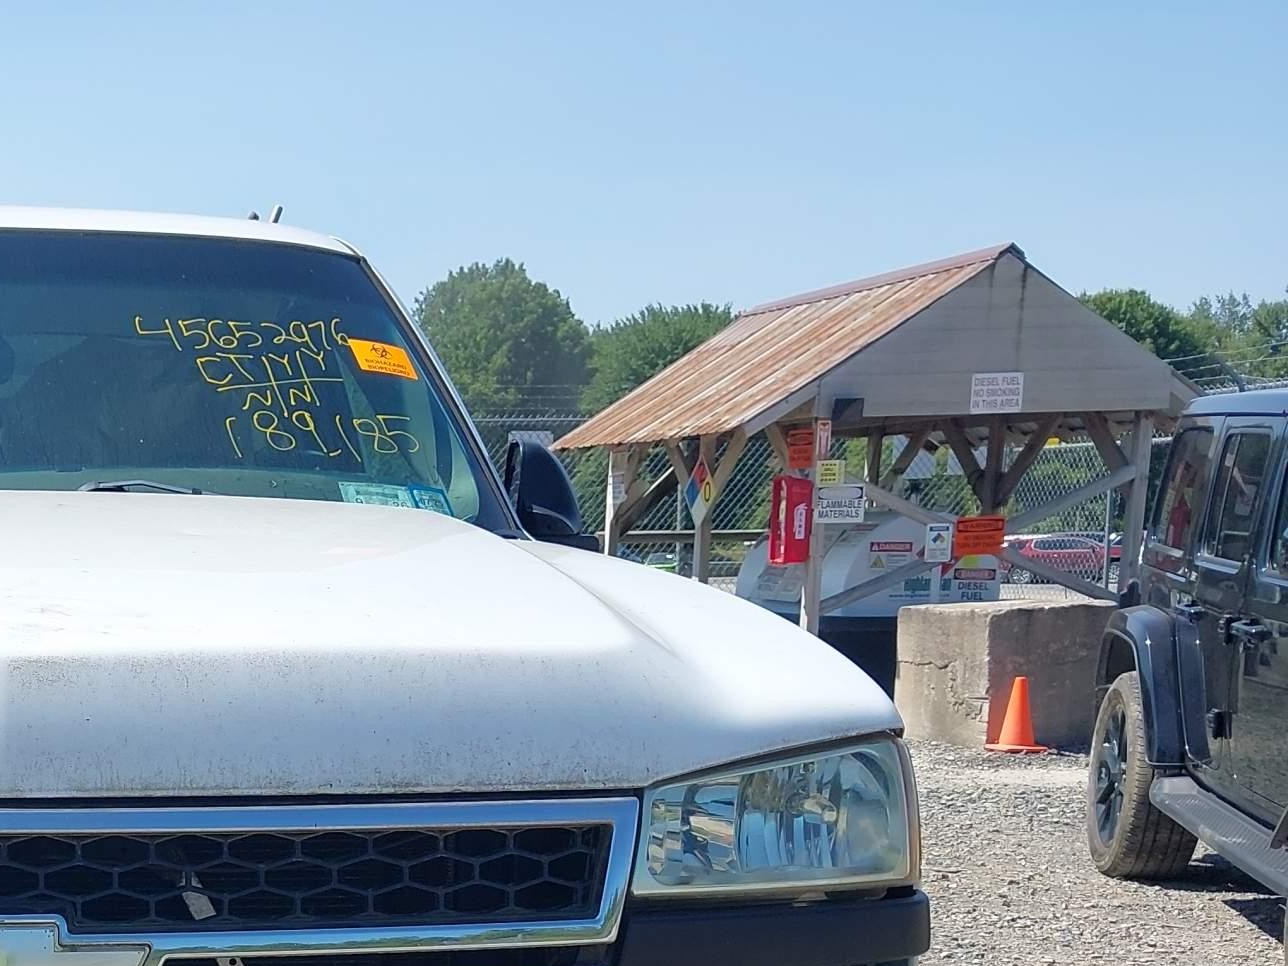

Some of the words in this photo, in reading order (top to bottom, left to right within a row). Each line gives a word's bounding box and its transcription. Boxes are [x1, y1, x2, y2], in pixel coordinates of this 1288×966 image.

[135, 316, 349, 351] 45652976
[974, 376, 1000, 386] DIESEL
[1003, 376, 1021, 386] FUEL
[973, 388, 984, 397] NO
[986, 387, 1020, 397] SMOKING
[982, 399, 998, 408] THIS
[1000, 398, 1020, 408] AREA
[817, 500, 862, 509] FLAMMABLE
[817, 509, 860, 519] MATERIALS
[958, 581, 989, 591] DIESEL
[961, 591, 984, 601] FUEL
